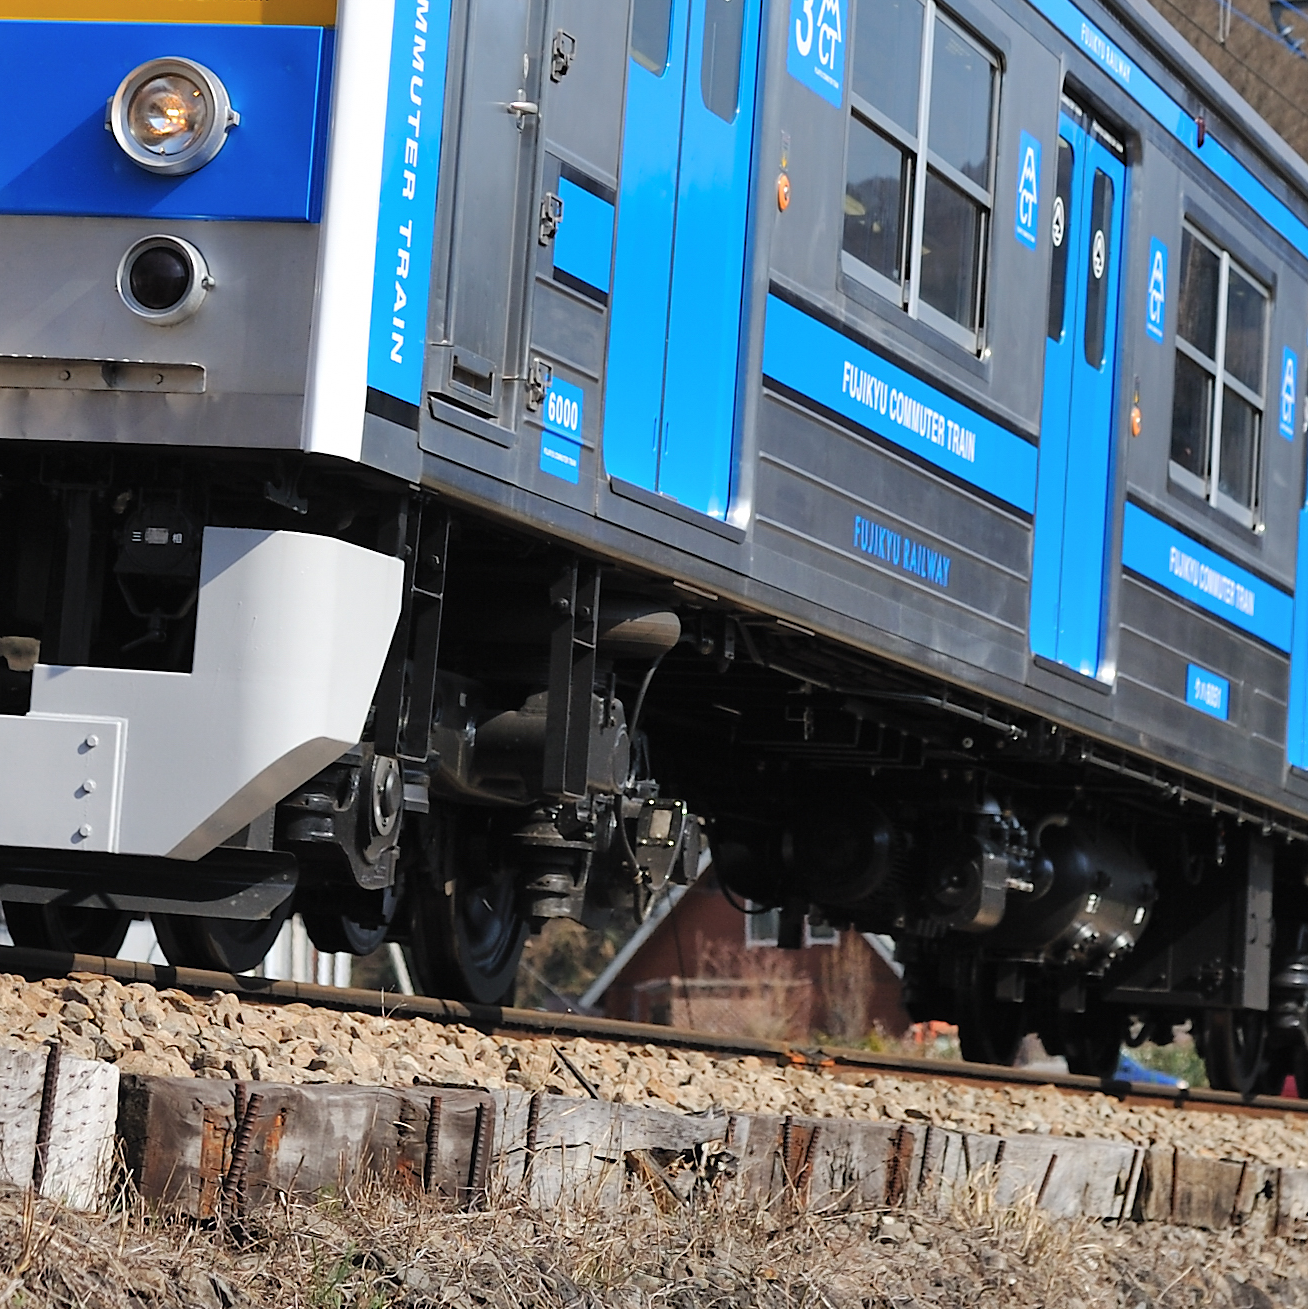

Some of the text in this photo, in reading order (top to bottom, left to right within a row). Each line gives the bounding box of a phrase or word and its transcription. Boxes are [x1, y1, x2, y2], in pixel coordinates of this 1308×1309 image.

[389, 219, 413, 364] TRAIN
[548, 391, 579, 431] 6000
[842, 360, 977, 463] FUJIKYU COMMUTER TRAIN
[853, 515, 951, 588] FUJIKYU RAILWAY
